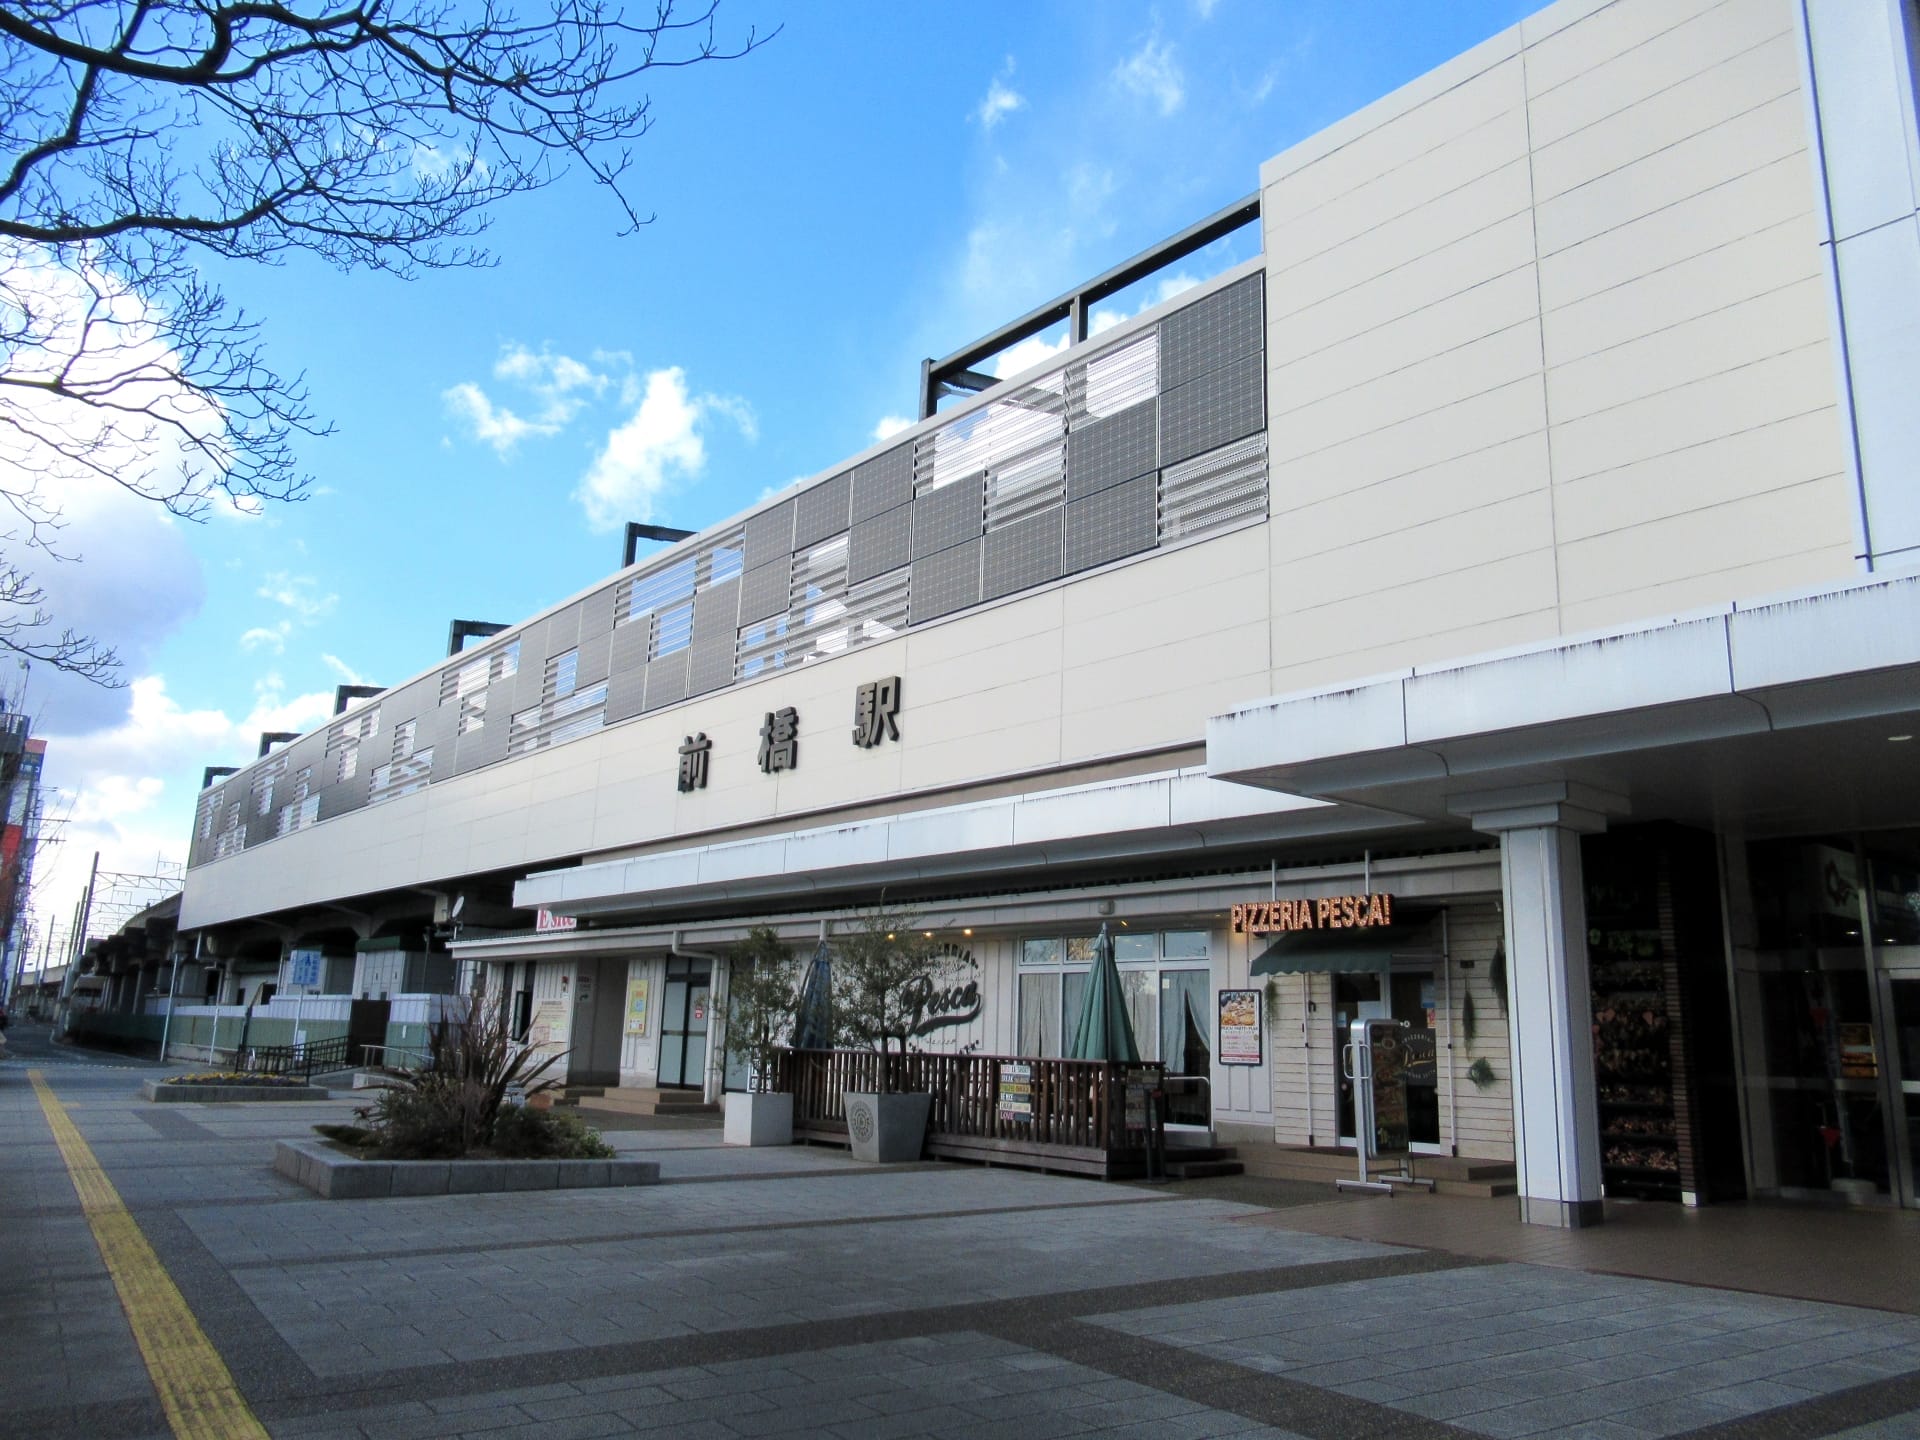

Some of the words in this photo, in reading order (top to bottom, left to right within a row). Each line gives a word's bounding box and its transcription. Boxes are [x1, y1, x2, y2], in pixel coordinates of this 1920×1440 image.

[677, 676, 901, 793] 前橋駅
[1231, 900, 1313, 933] PIZZERIA
[1317, 893, 1391, 929] PESCA!
[900, 973, 982, 1037] Pesca
